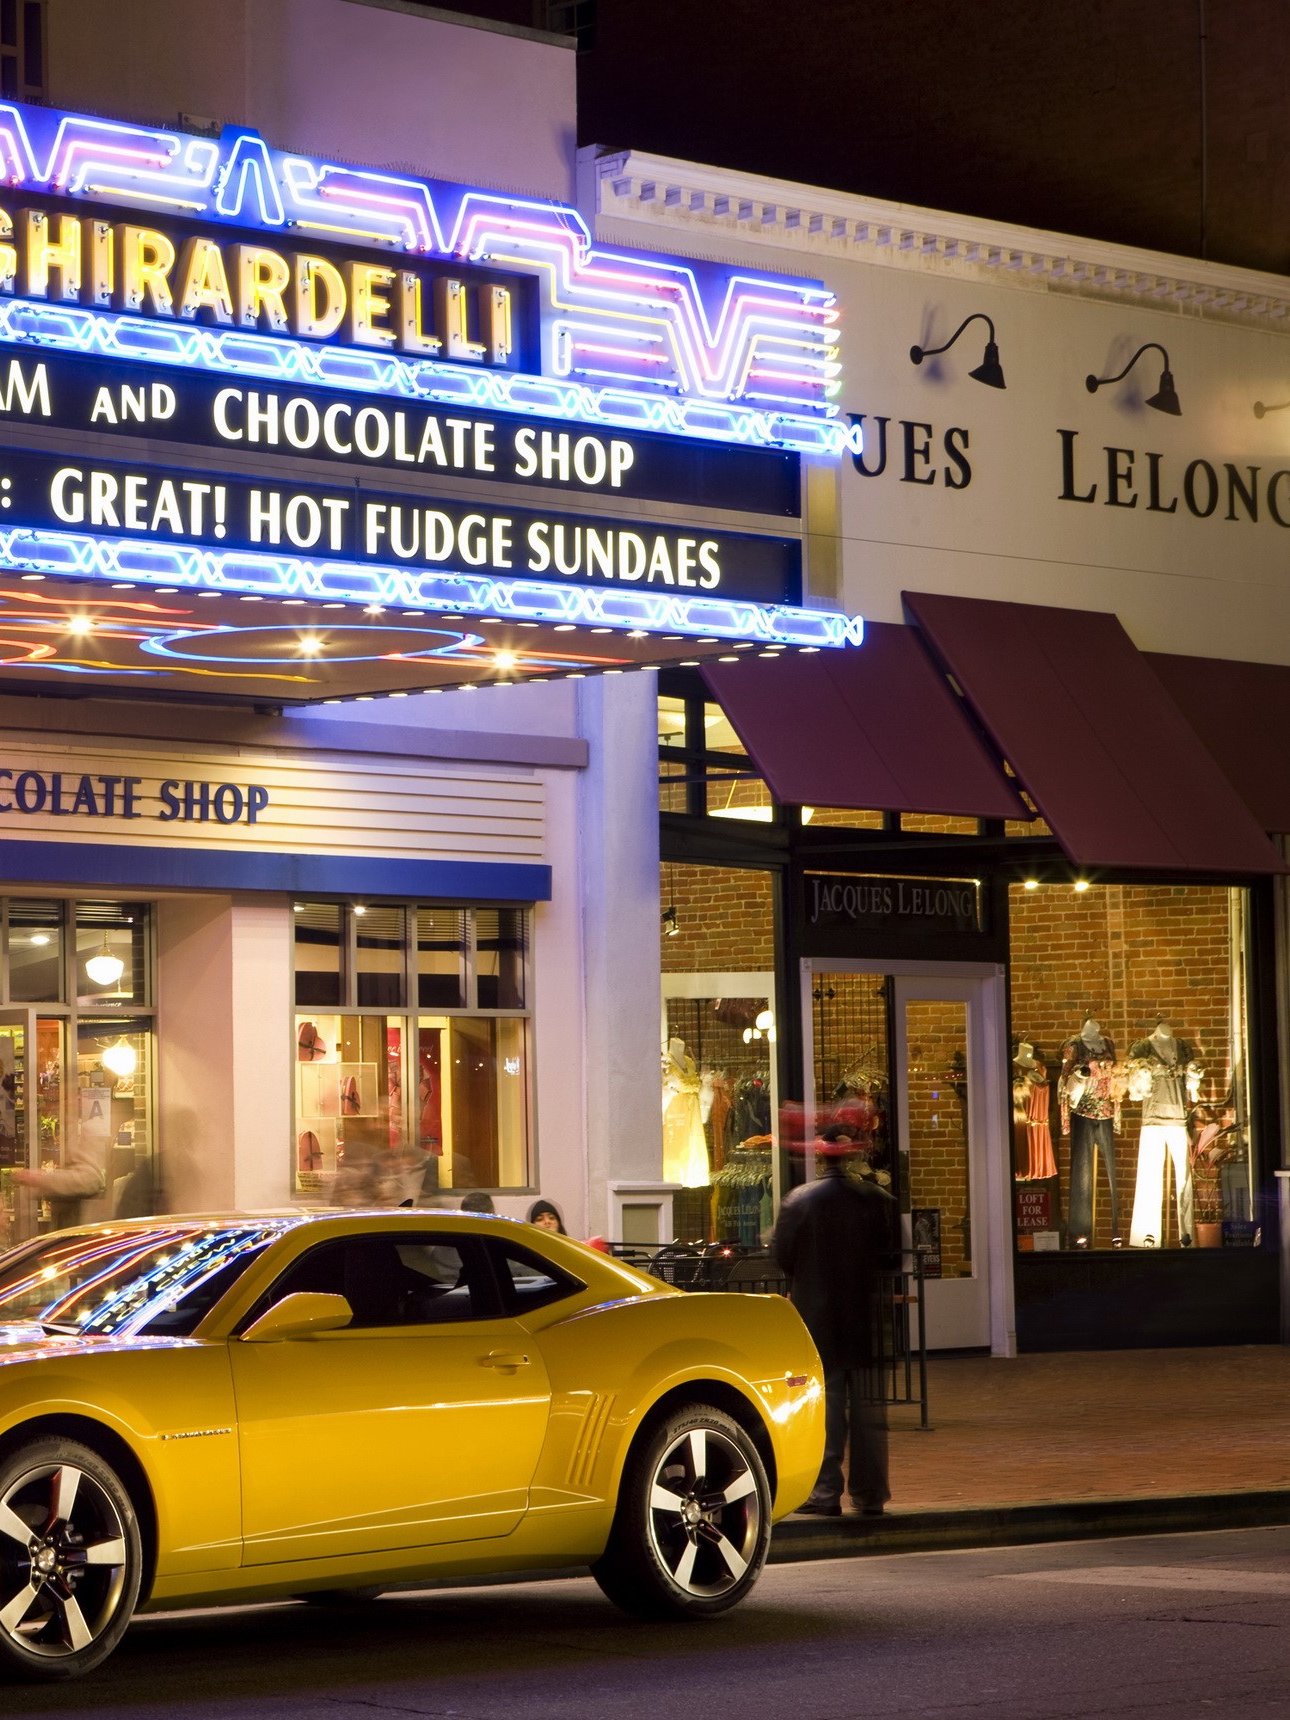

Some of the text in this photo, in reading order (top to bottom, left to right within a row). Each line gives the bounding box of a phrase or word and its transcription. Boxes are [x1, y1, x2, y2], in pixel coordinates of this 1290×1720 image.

[91, 382, 177, 423] AND
[213, 387, 495, 472] CHOCOLATE
[514, 427, 635, 489] SHOP
[49, 467, 228, 540] GREAT!
[249, 490, 350, 552] HOT
[365, 503, 514, 570] FUDGE
[527, 520, 722, 591] SUNDAES
[159, 779, 269, 825] SHOP
[811, 879, 973, 923] JACQUES LELONG
[1018, 1216, 1048, 1226] LEASE
[1019, 1194, 1044, 1204] LOFT
[1022, 1206, 1042, 1215] FOR
